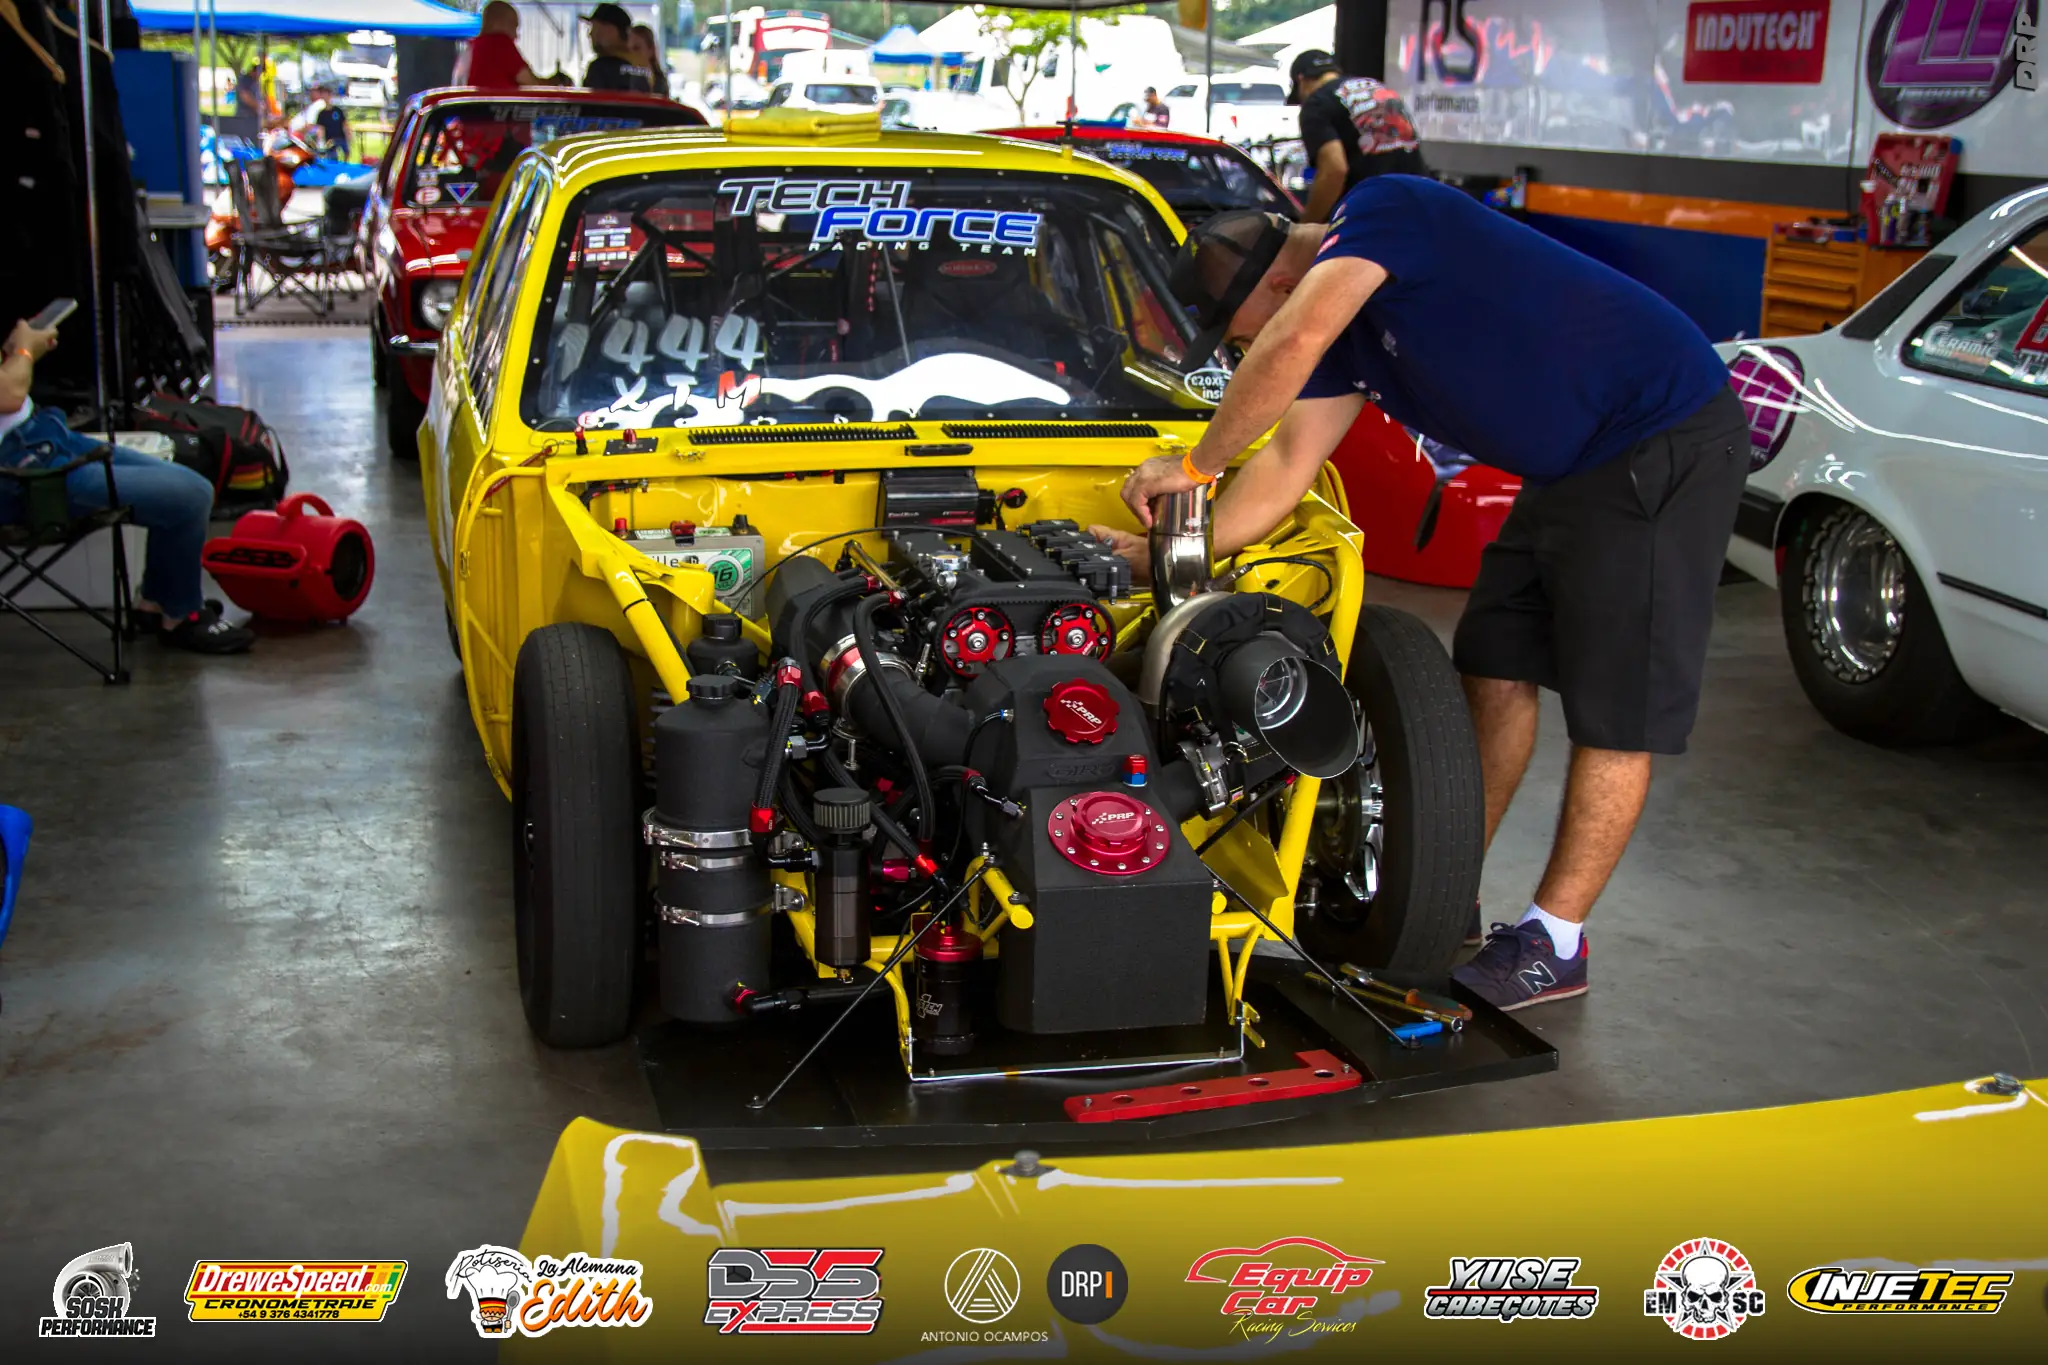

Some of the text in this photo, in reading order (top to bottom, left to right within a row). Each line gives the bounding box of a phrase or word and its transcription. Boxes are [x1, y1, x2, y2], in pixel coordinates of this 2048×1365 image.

[1695, 11, 1816, 51] INDUTECH
[719, 176, 911, 216] TECH
[808, 241, 1037, 257] RACING TEAM
[1202, 386, 1224, 399] insi
[1076, 705, 1102, 725] PRP
[1107, 812, 1135, 821] PRP
[1517, 960, 1557, 995] N
